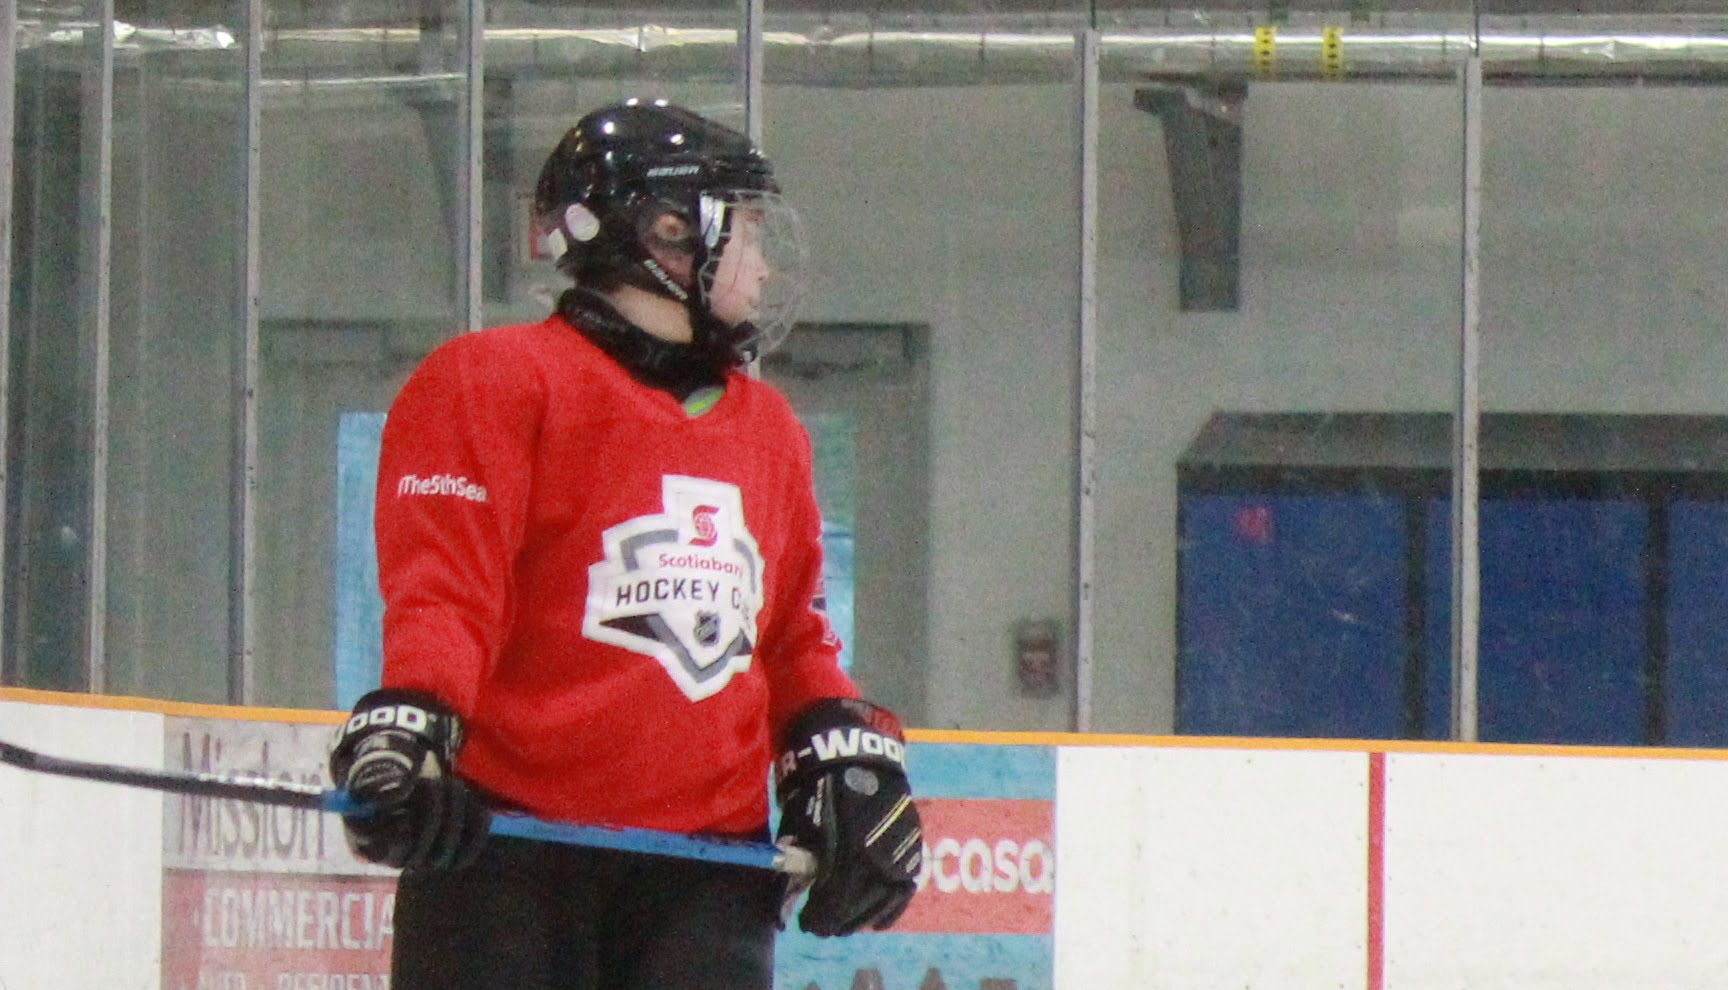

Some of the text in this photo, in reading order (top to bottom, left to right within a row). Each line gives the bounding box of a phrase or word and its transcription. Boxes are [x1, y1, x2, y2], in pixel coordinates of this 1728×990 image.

[658, 553, 743, 579] Scotiaban
[615, 578, 720, 607] HOCKEY
[346, 704, 427, 735] OOD
[203, 888, 397, 949] COMMERCIA
